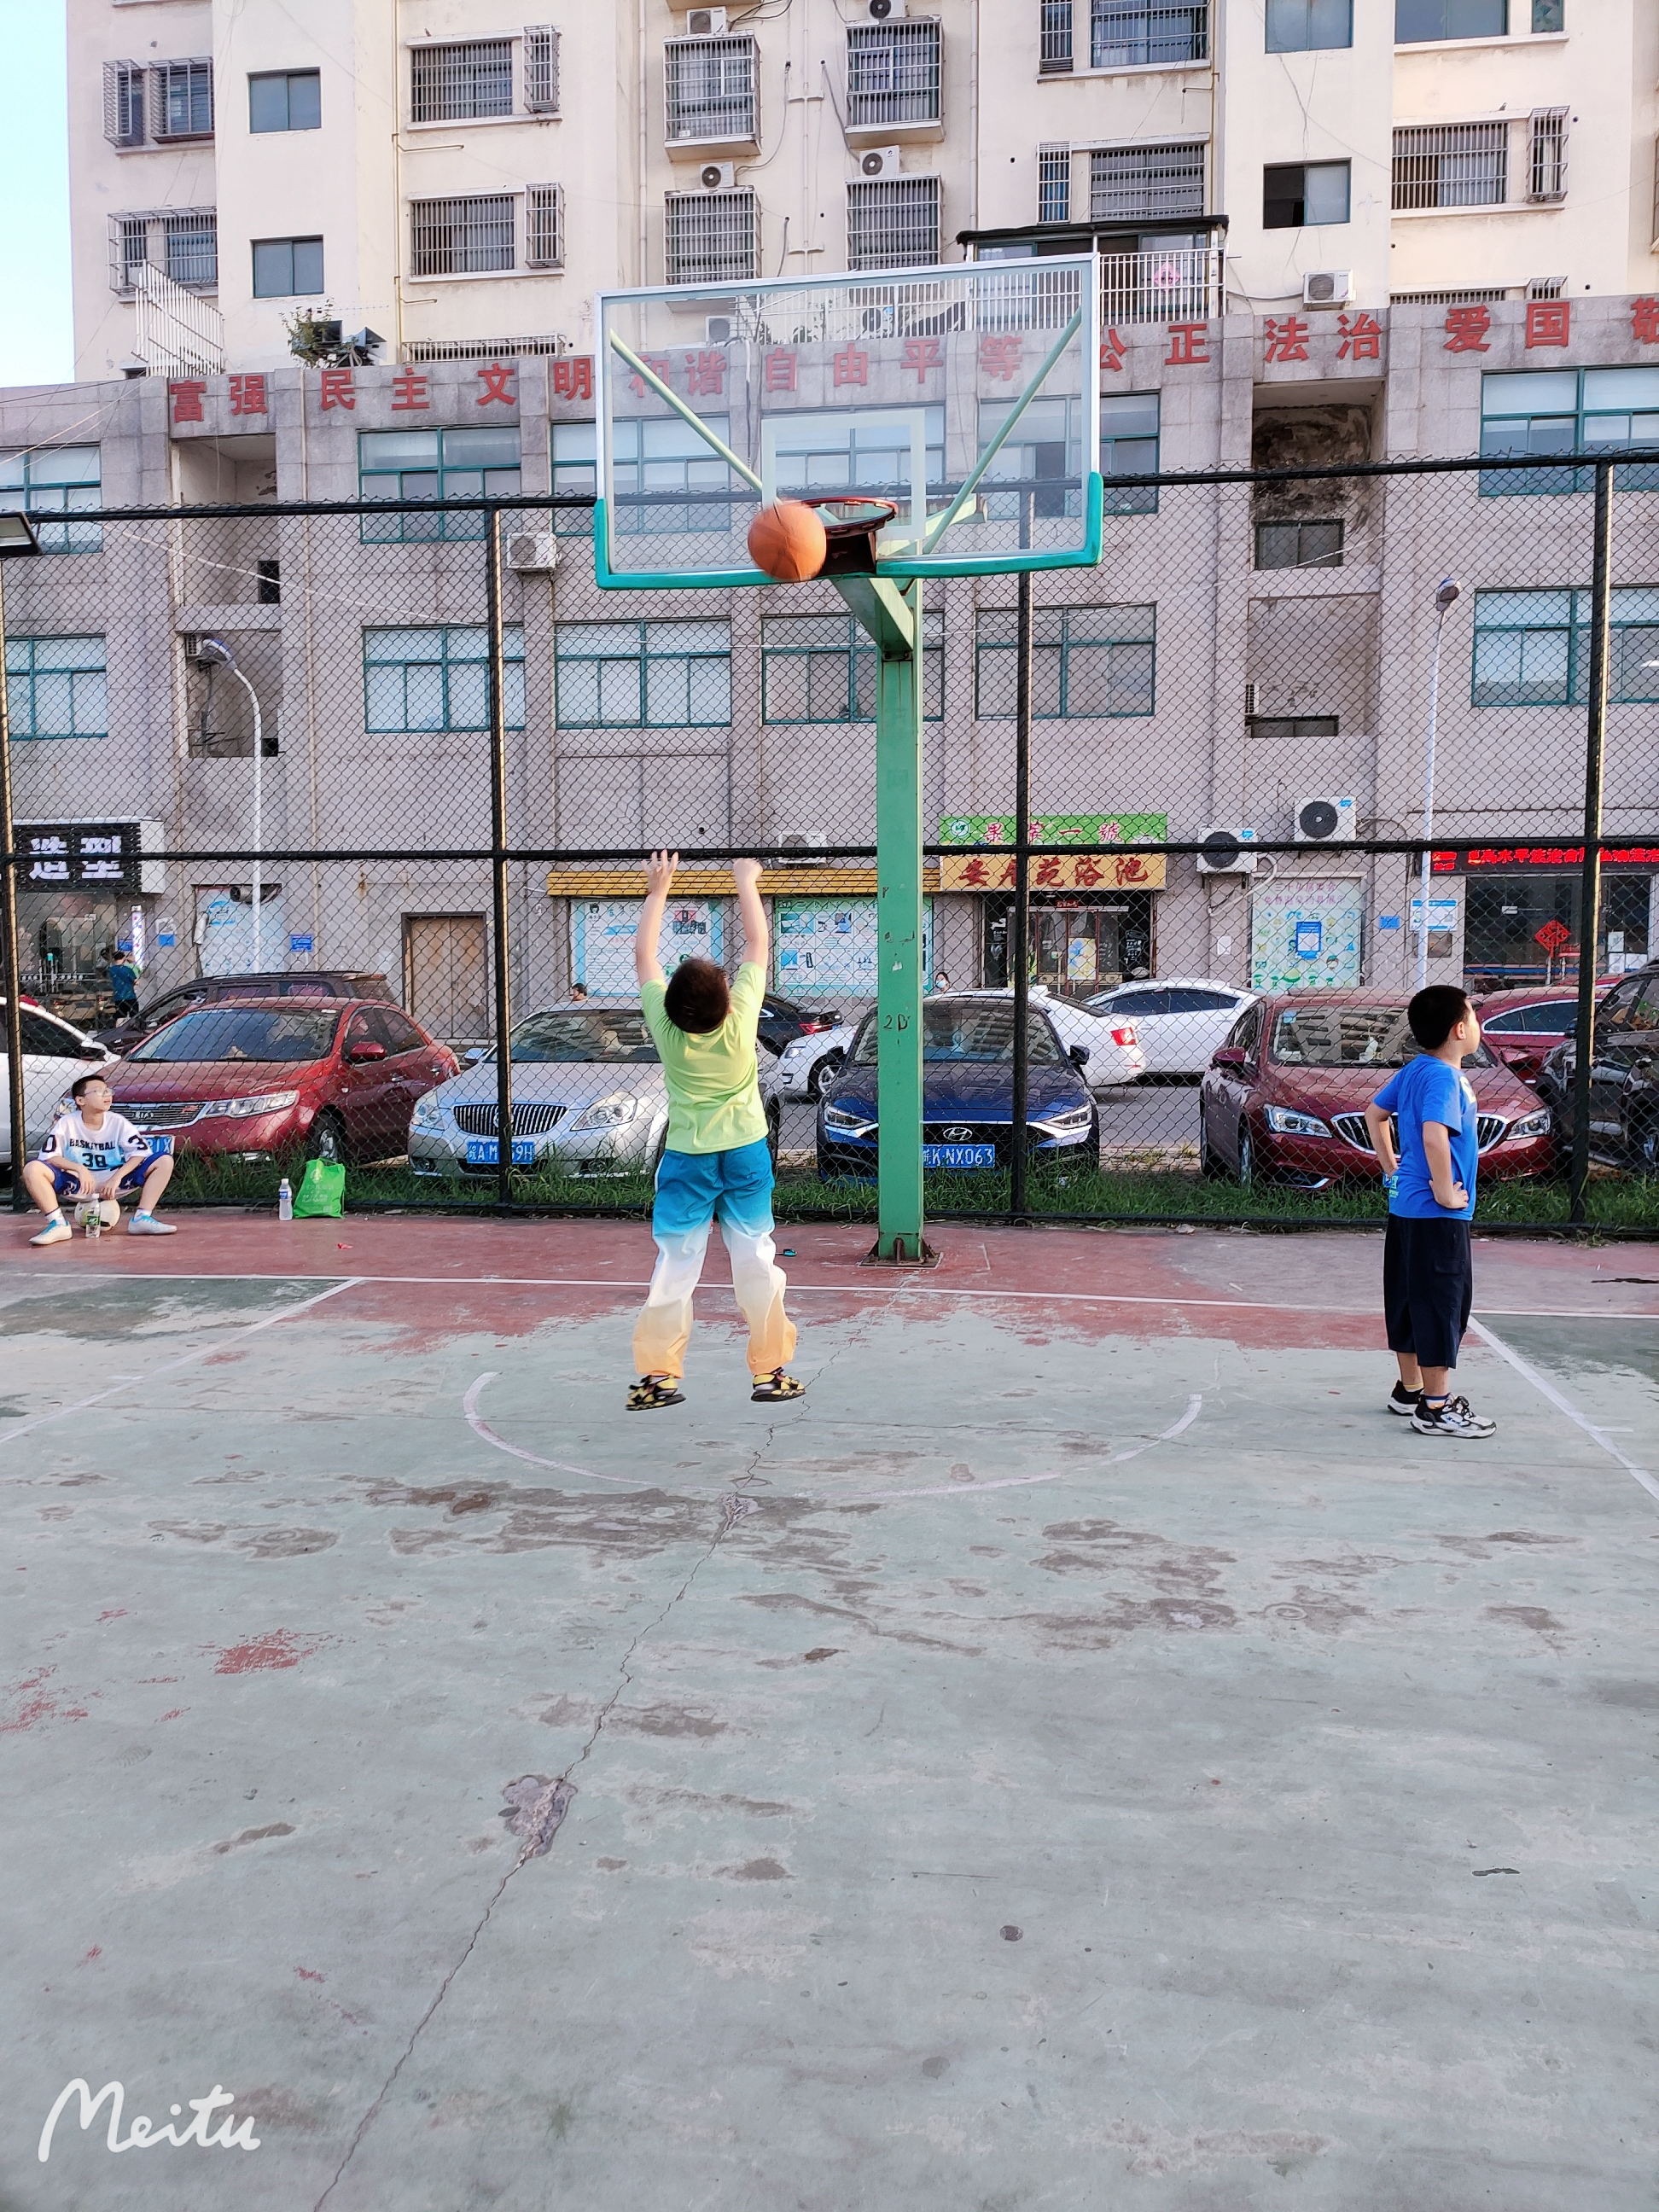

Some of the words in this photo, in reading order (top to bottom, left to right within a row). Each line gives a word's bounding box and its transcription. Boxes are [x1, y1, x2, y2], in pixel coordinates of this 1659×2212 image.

[170, 375, 268, 423] 富强
[320, 367, 431, 411] 民主
[477, 357, 593, 406] 文明
[765, 342, 869, 393] 自由
[1264, 313, 1382, 364] 法治
[1443, 301, 1572, 353] 爱国
[29, 835, 125, 881] 造型
